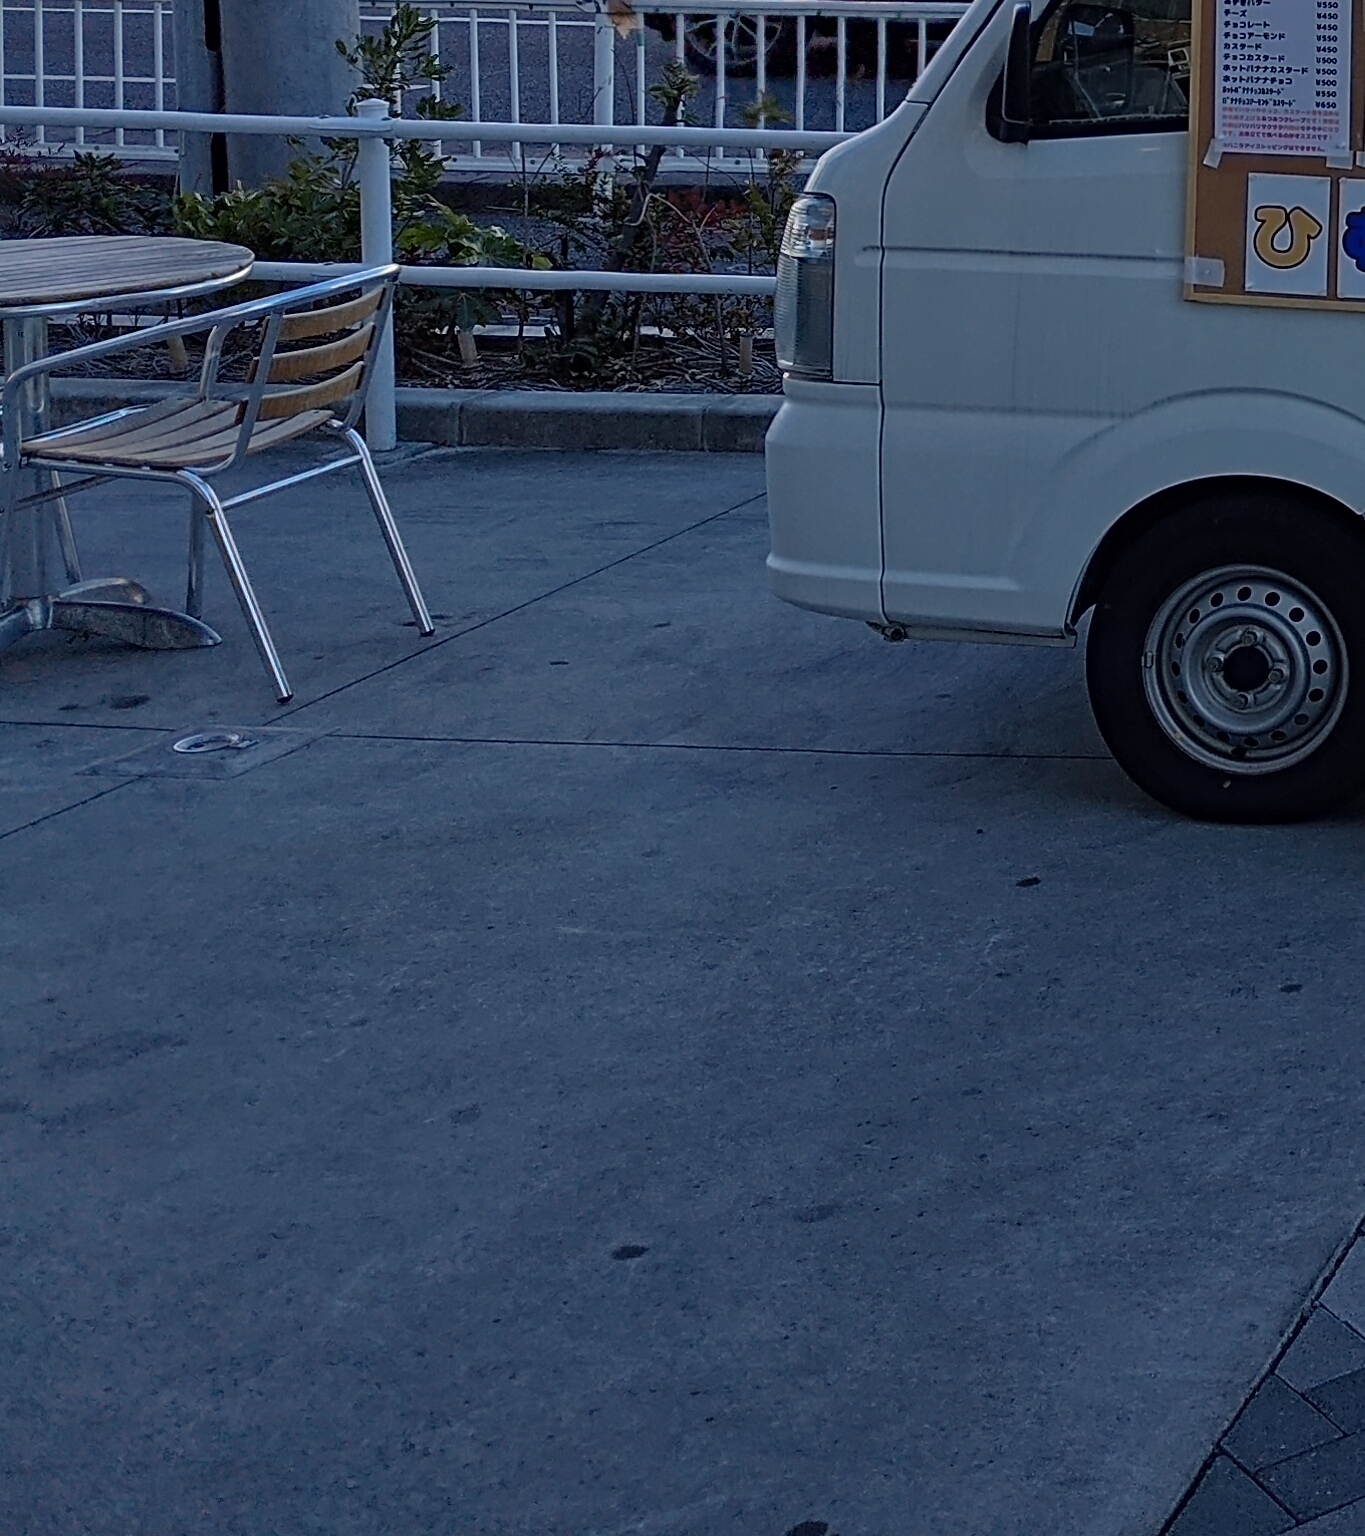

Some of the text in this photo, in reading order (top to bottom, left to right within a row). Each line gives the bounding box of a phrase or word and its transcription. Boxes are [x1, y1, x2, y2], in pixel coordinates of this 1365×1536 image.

[1224, 9, 1247, 17] チーズ
[1224, 43, 1262, 51] カスタード
[1223, 53, 1285, 62] チョコカスタード
